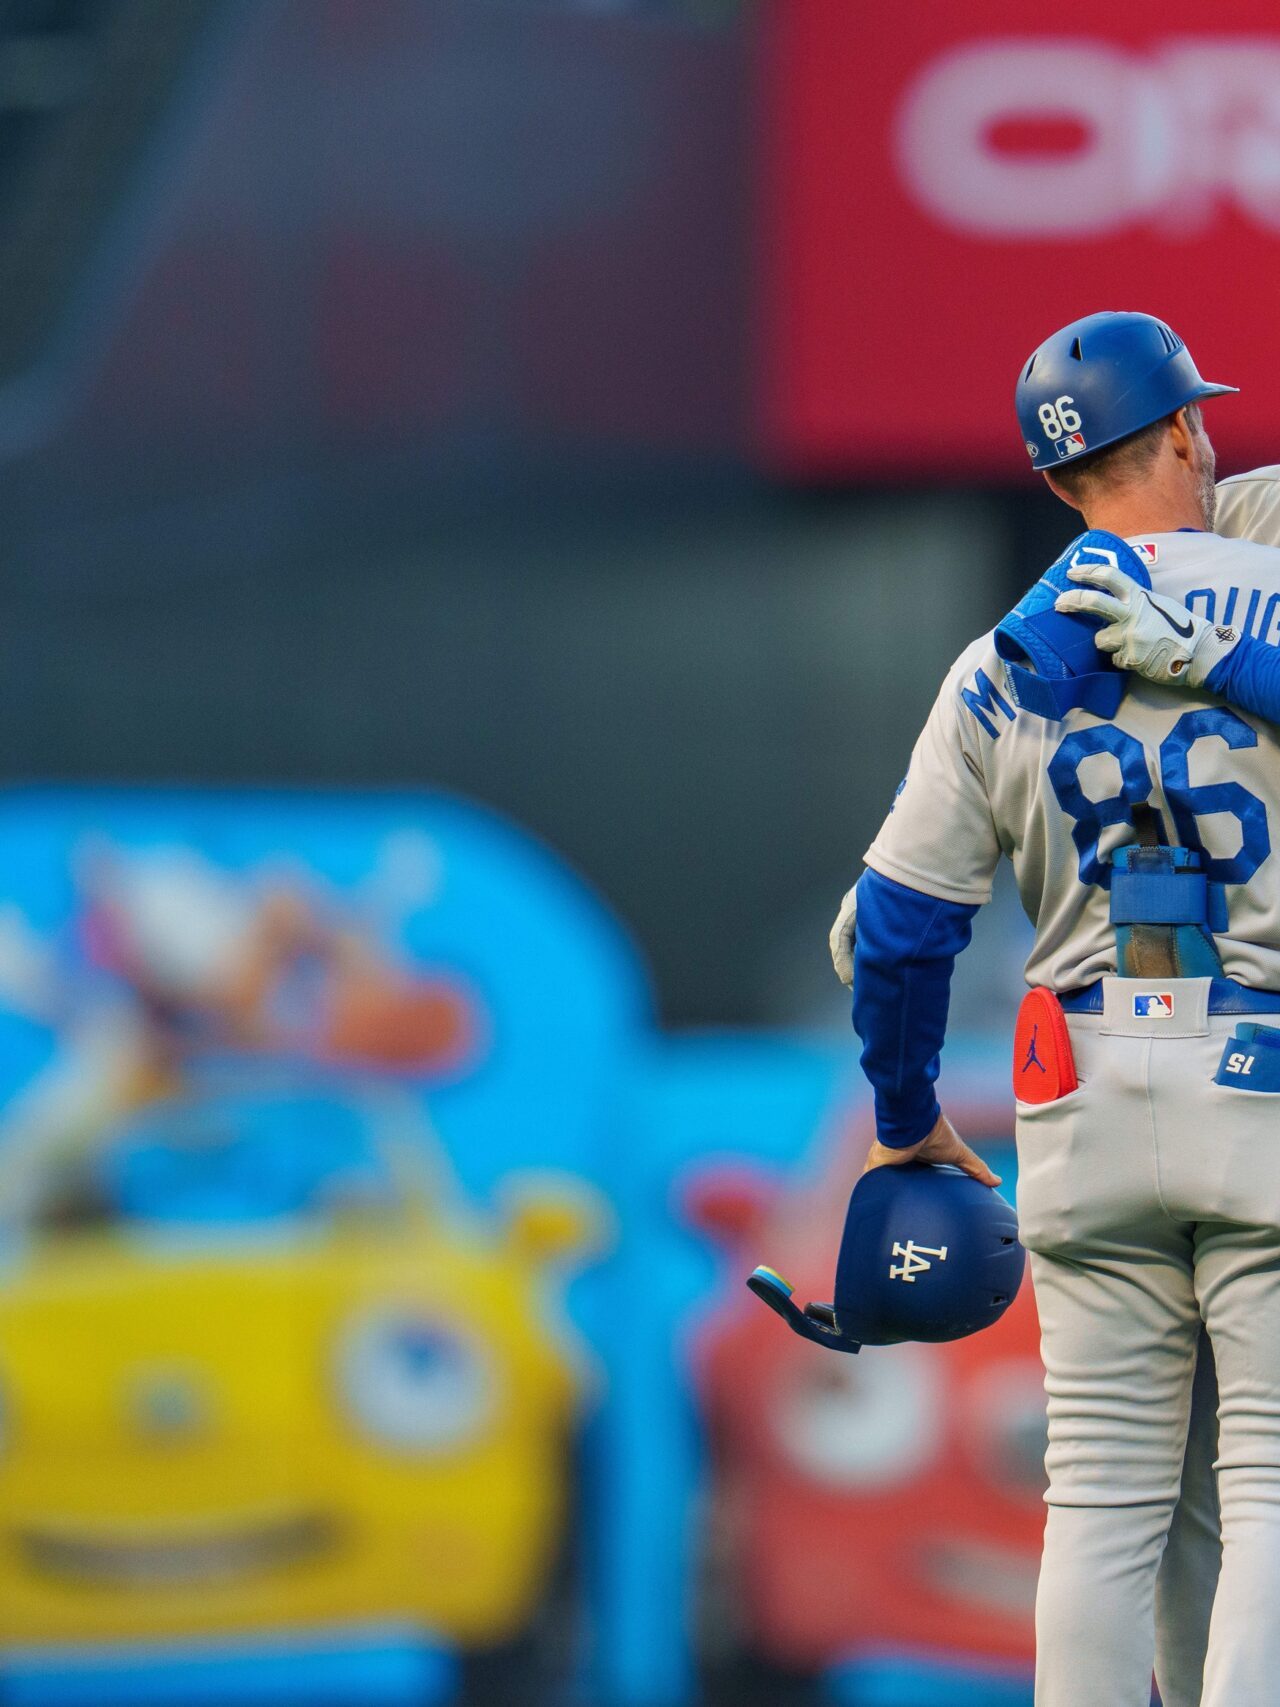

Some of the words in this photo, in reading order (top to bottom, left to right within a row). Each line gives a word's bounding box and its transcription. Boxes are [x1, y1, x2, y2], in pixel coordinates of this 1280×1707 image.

[1038, 395, 1082, 440] 86
[1047, 706, 1271, 888] 86
[1225, 1052, 1255, 1075] 15
[889, 1240, 947, 1282] LA
